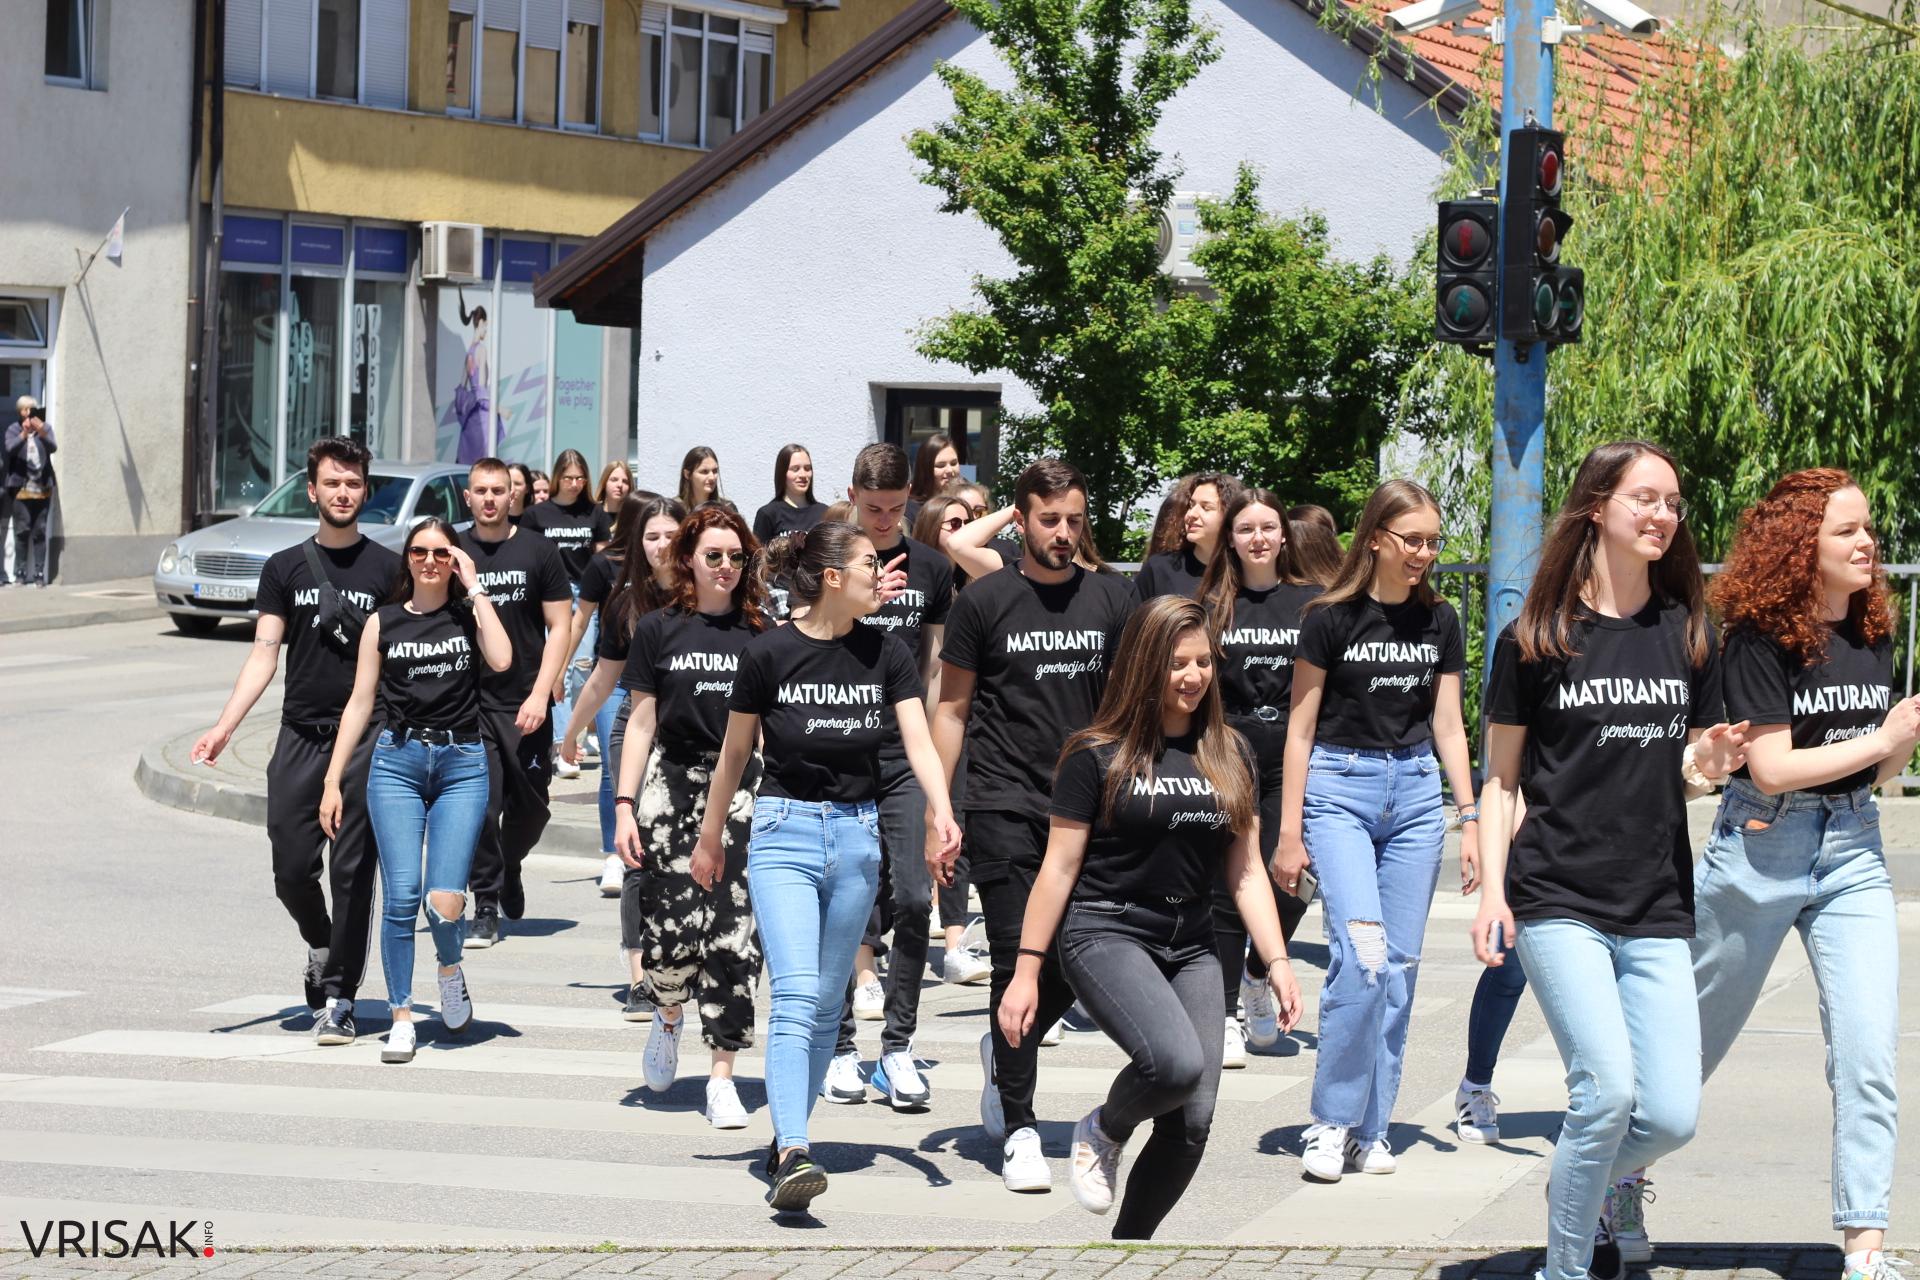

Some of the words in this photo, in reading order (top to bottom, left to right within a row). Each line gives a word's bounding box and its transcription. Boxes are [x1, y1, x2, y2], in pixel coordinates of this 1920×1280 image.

[476, 570, 521, 587] TURANTI
[512, 587, 527, 601] 65.
[905, 611, 921, 628] 65.
[388, 636, 467, 659] MATURANTI
[1007, 630, 1101, 653] MATURANTI
[1221, 628, 1300, 646] MATURANT
[1243, 654, 1288, 670] generacija
[1343, 642, 1435, 663] MATURANTI
[408, 662, 452, 679] generacija
[1035, 661, 1085, 680] generacija
[778, 682, 877, 705] MATURANTI
[1368, 675, 1419, 693] generacija
[1559, 677, 1685, 710] MATURANTI
[1793, 684, 1890, 716] MATURANTI
[805, 717, 862, 736] generacija
[865, 709, 883, 729] 65.
[1597, 723, 1665, 748] generacija
[1133, 776, 1219, 797] MATURA
